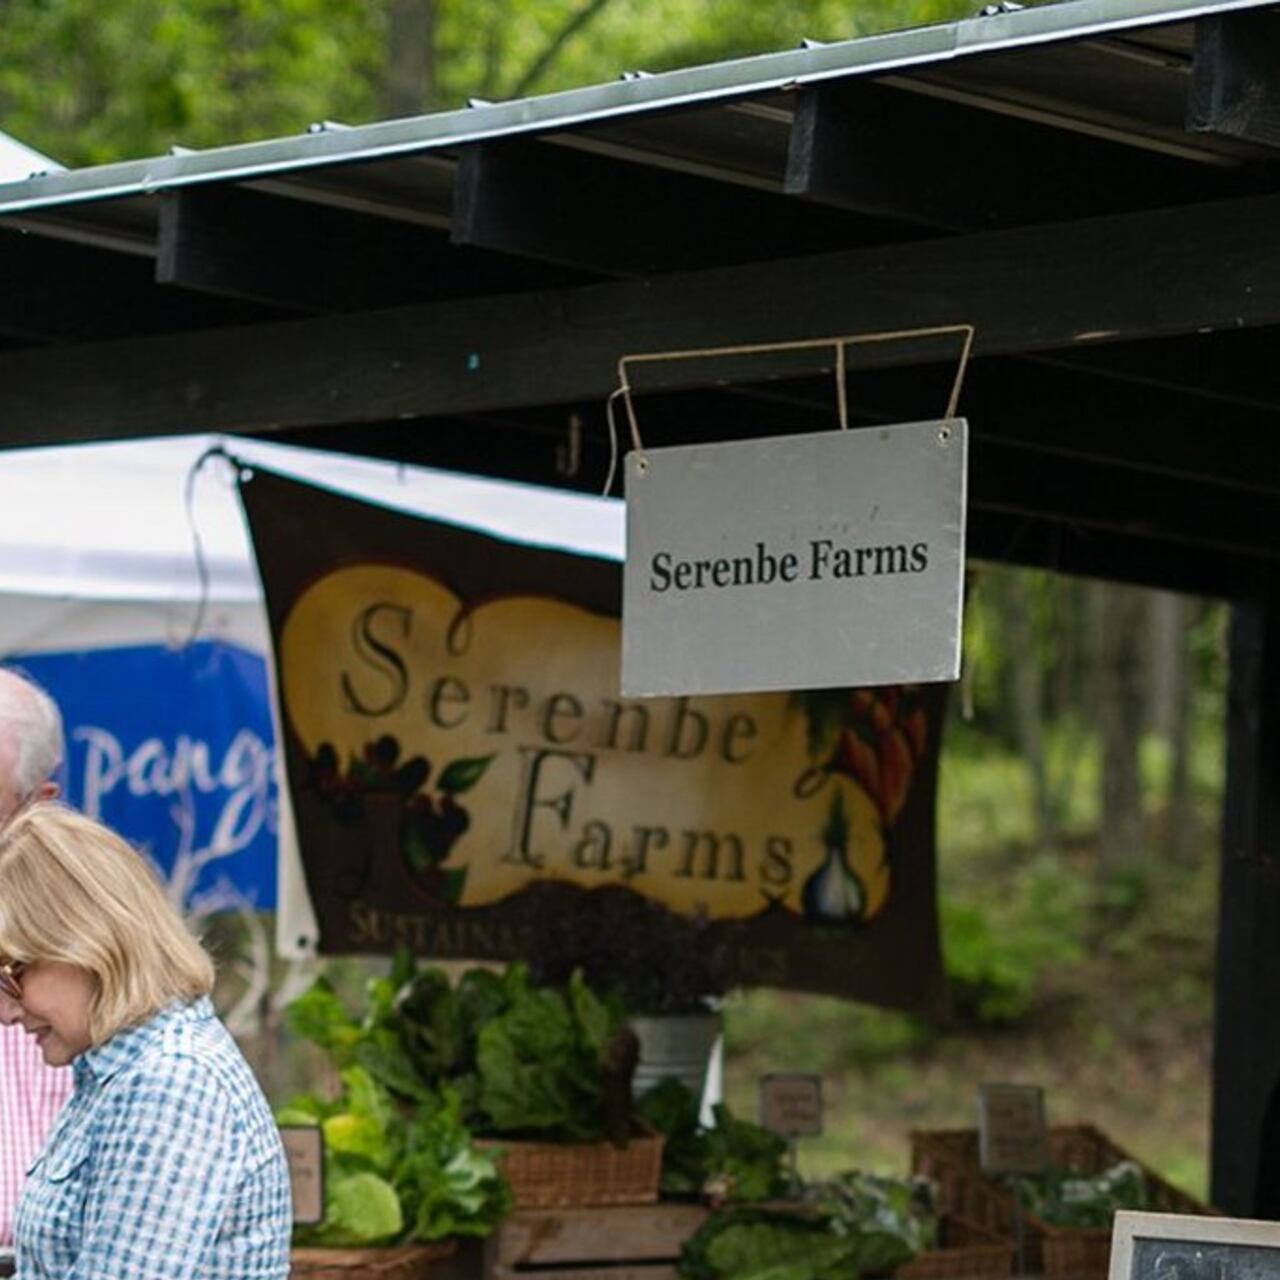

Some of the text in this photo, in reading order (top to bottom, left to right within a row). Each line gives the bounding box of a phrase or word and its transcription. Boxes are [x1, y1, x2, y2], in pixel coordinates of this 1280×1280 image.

[650, 540, 929, 593] Serenbe Farms
[340, 601, 758, 764] Serenbe
[72, 726, 278, 857] pang
[500, 745, 794, 885] Farms
